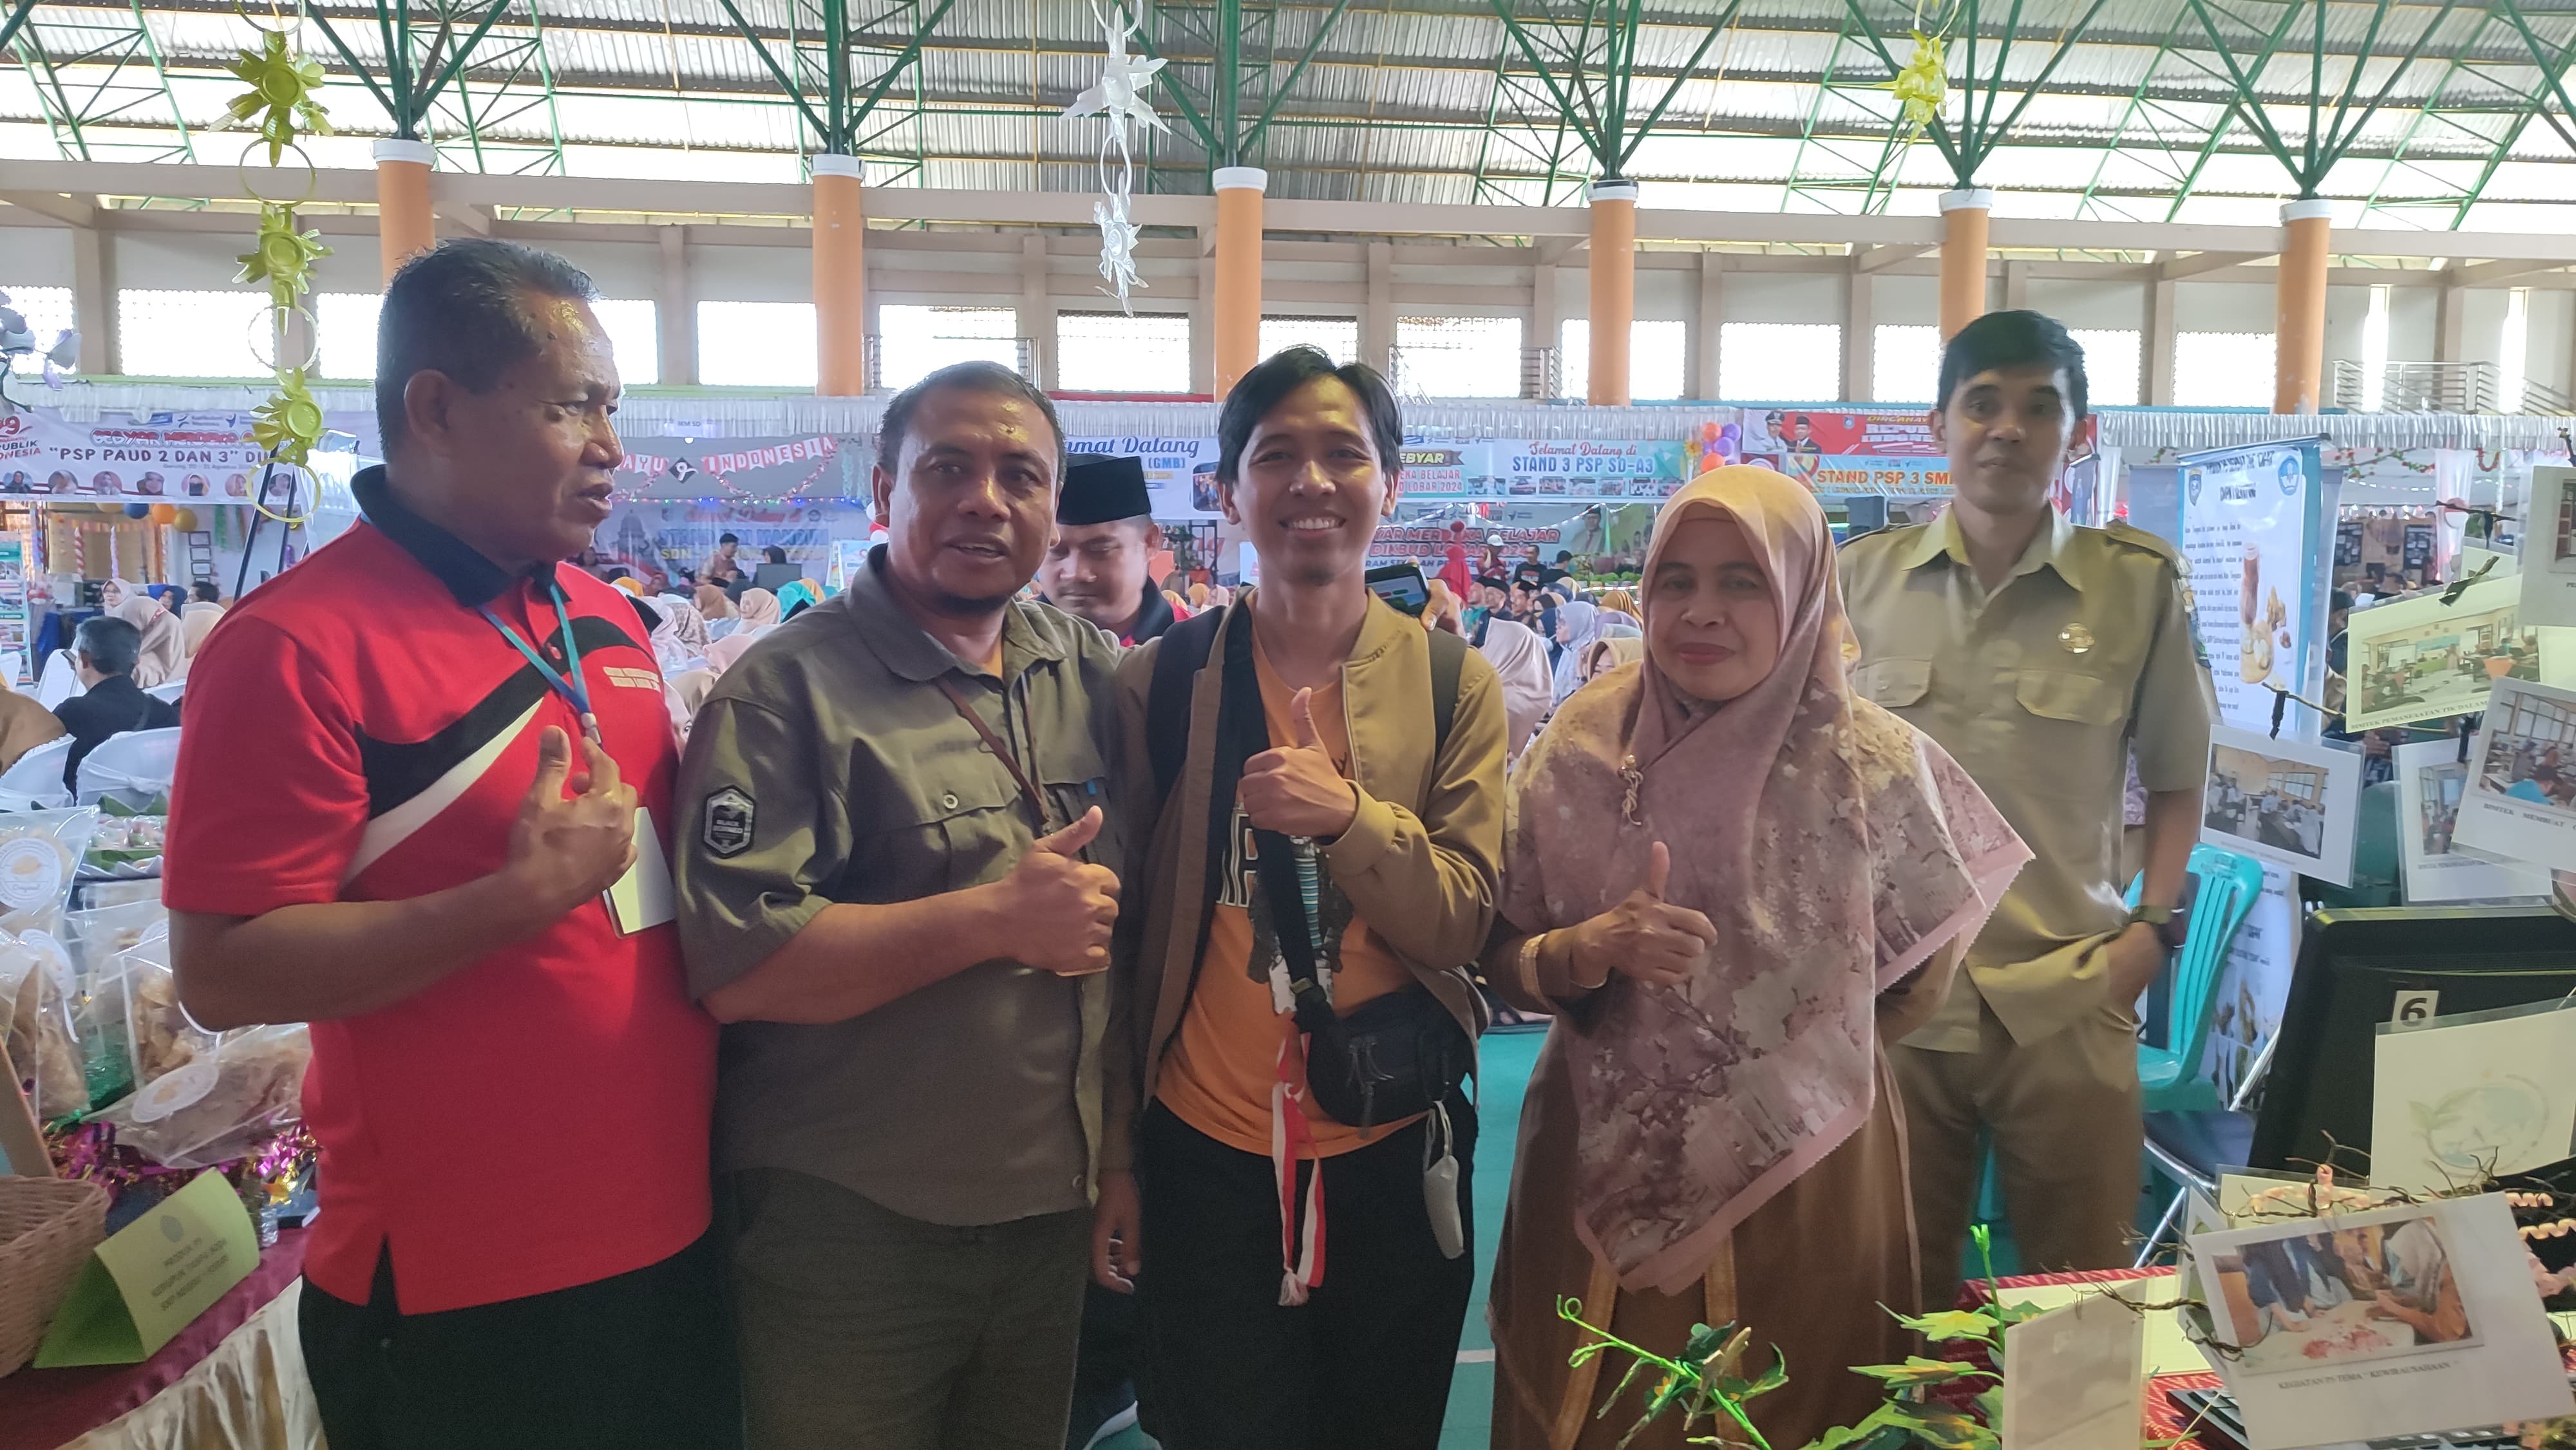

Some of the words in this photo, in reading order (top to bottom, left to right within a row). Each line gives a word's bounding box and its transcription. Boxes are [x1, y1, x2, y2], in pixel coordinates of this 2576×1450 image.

[0, 440, 37, 451] UBLIK
[1122, 436, 1200, 458] Datang
[1529, 441, 1577, 456] Selamat
[1580, 442, 1622, 459] Datang
[1626, 444, 1637, 456] di
[103, 449, 152, 462] PAUD
[159, 450, 169, 462] 2
[175, 450, 211, 462] DAN
[709, 437, 835, 472] INDONESIA
[1148, 457, 1186, 469] (GMB)
[1513, 456, 1557, 472] STAND
[1562, 457, 1571, 472] 3
[1576, 457, 1603, 473] PSP
[1608, 457, 1654, 473] SD-A3
[1421, 469, 1461, 480] BELAJAR
[1817, 470, 1868, 483] STAND
[1874, 471, 1905, 484] PSP
[1911, 471, 1919, 484] 3
[1408, 482, 1437, 492] LOBAR
[1441, 482, 1463, 492] 2024
[1369, 543, 1432, 557] DIKBUD
[2400, 997, 2427, 1027] 6
